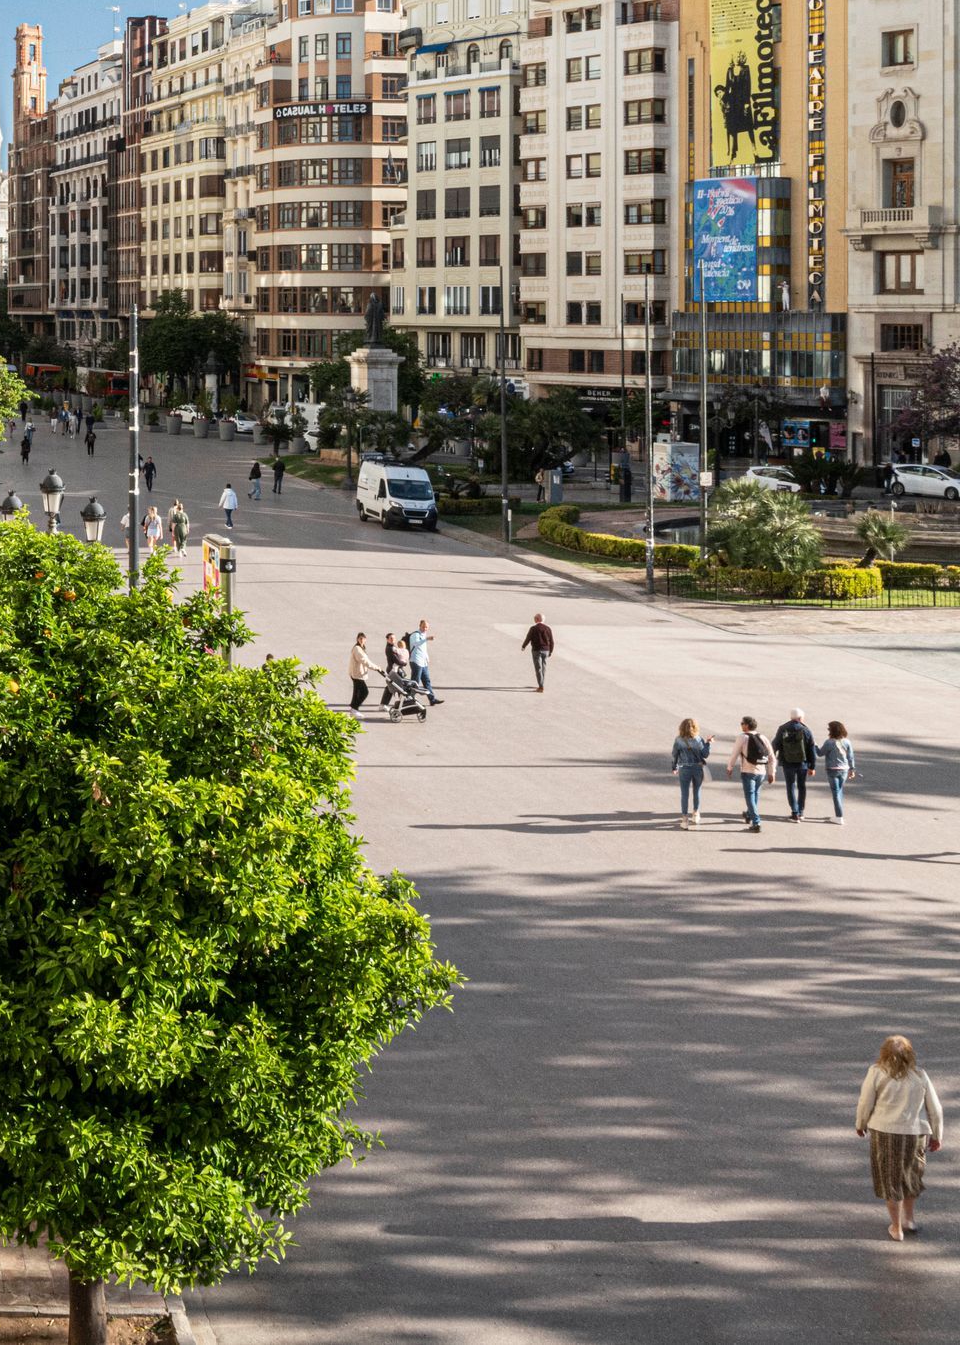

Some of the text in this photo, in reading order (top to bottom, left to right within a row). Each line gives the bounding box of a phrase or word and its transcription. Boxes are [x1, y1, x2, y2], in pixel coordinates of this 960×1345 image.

[282, 103, 367, 117] CASUAL HOTELES
[808, 33, 824, 131] TEATRE
[808, 153, 823, 303] FILMOTECA
